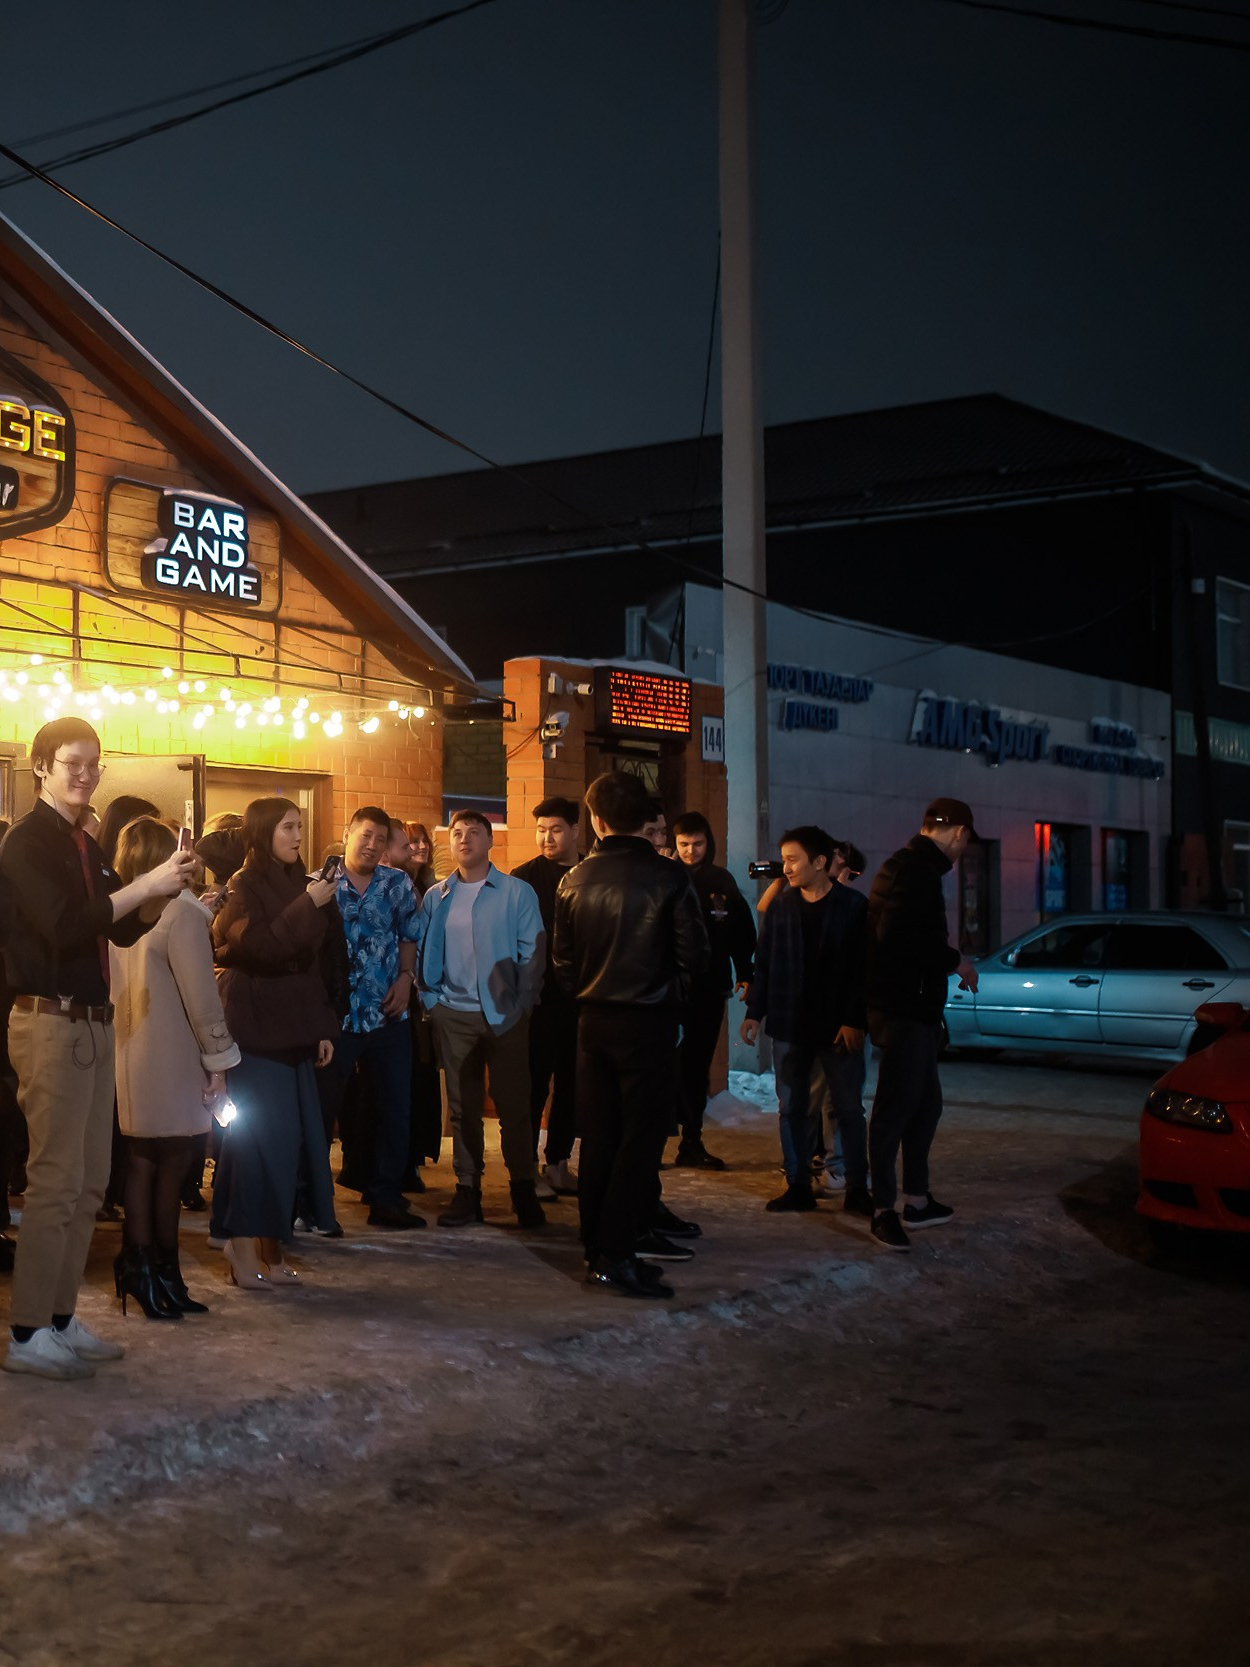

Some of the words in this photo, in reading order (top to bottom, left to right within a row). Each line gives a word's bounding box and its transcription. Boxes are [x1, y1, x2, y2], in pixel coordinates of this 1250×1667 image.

[174, 501, 246, 541] BAR
[170, 532, 245, 568] AND
[155, 558, 258, 601] GAME
[704, 725, 722, 752] 144
